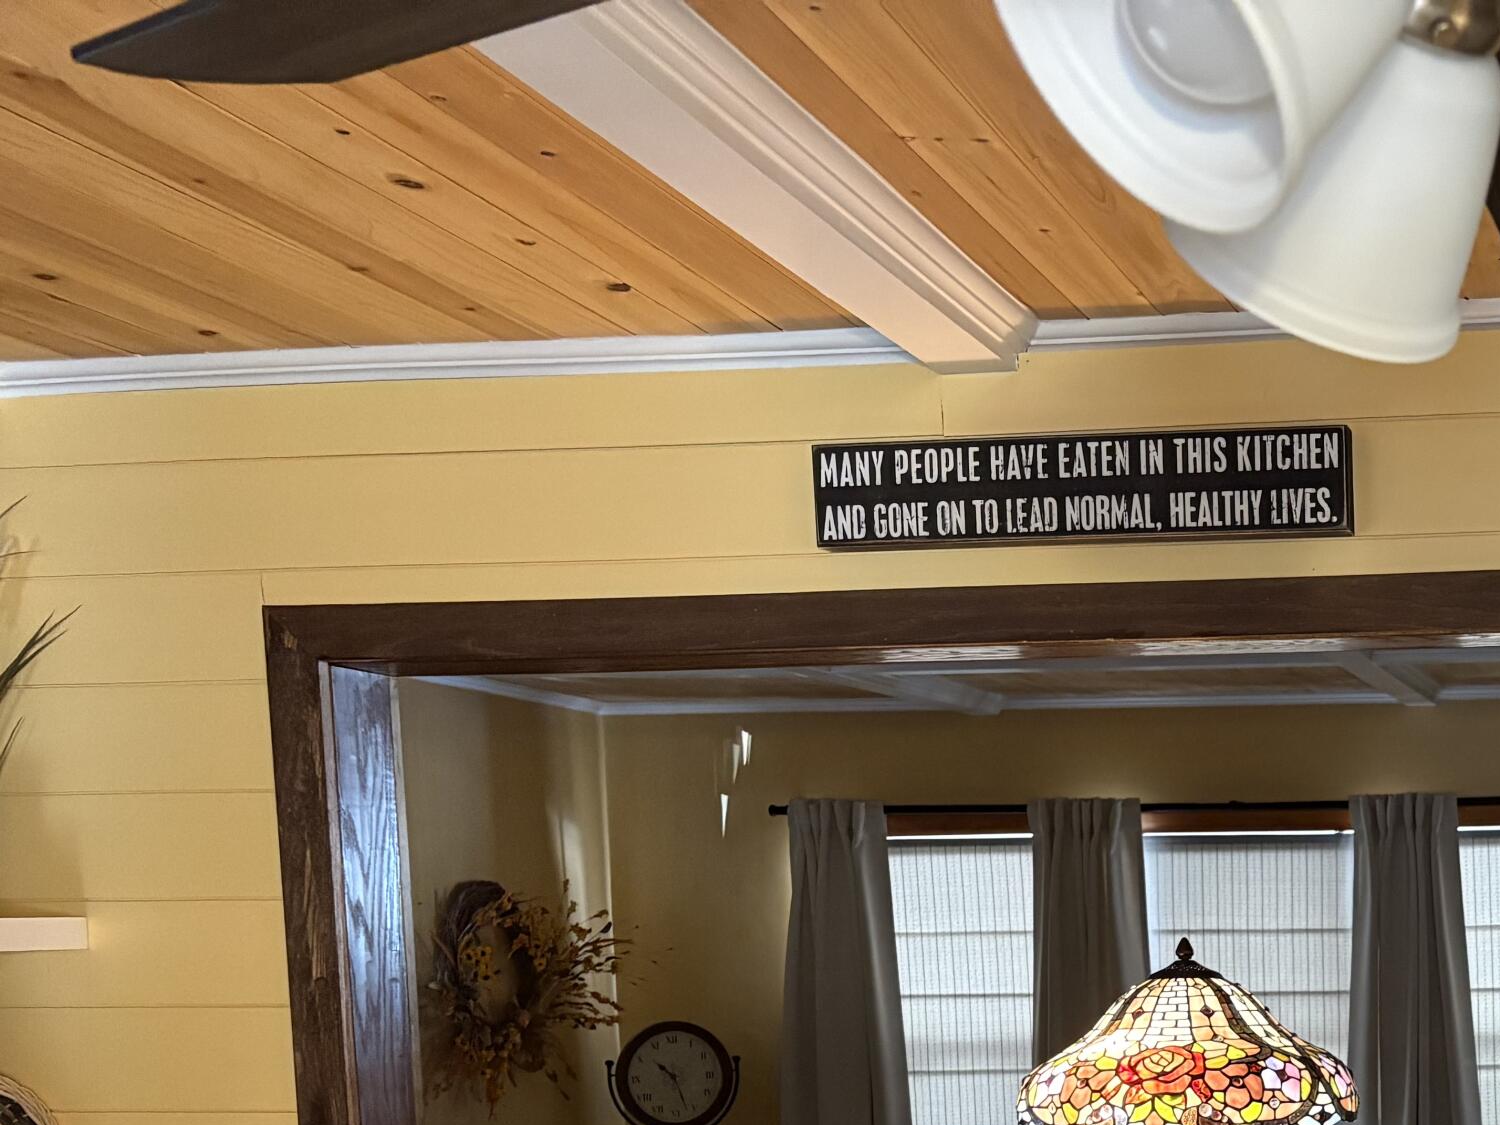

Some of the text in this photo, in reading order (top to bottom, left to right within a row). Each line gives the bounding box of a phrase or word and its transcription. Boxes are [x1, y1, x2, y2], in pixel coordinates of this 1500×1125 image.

[820, 432, 1339, 488] MANY PEOPLE HAVE EATEN IN THIS KITCHEN
[823, 487, 1338, 541] AND GONE ON TO LEAD NORMAL, HEALTHY LIVES.
